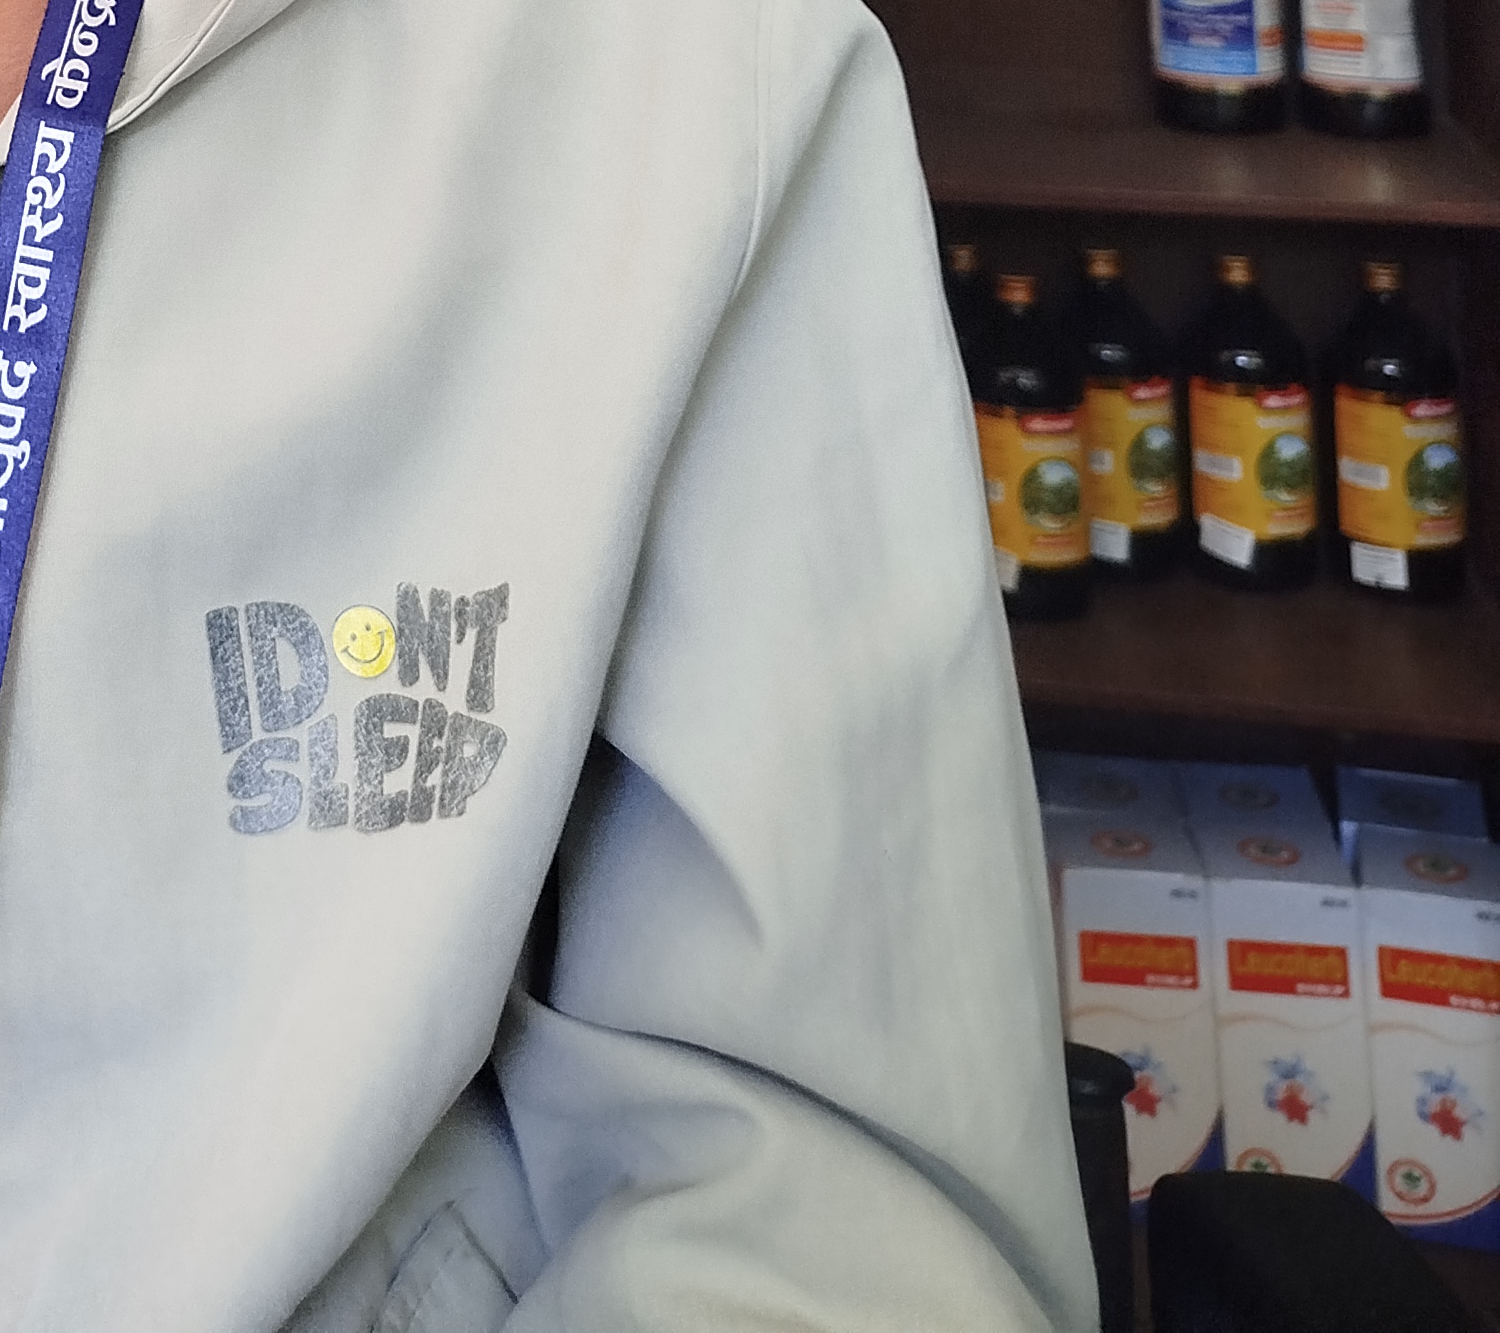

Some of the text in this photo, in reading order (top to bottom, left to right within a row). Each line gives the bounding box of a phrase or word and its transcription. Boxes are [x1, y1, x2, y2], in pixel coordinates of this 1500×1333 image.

[2, 119, 75, 334] स्वास्थ्य
[205, 605, 252, 754] I
[227, 693, 507, 834] SLEEP
